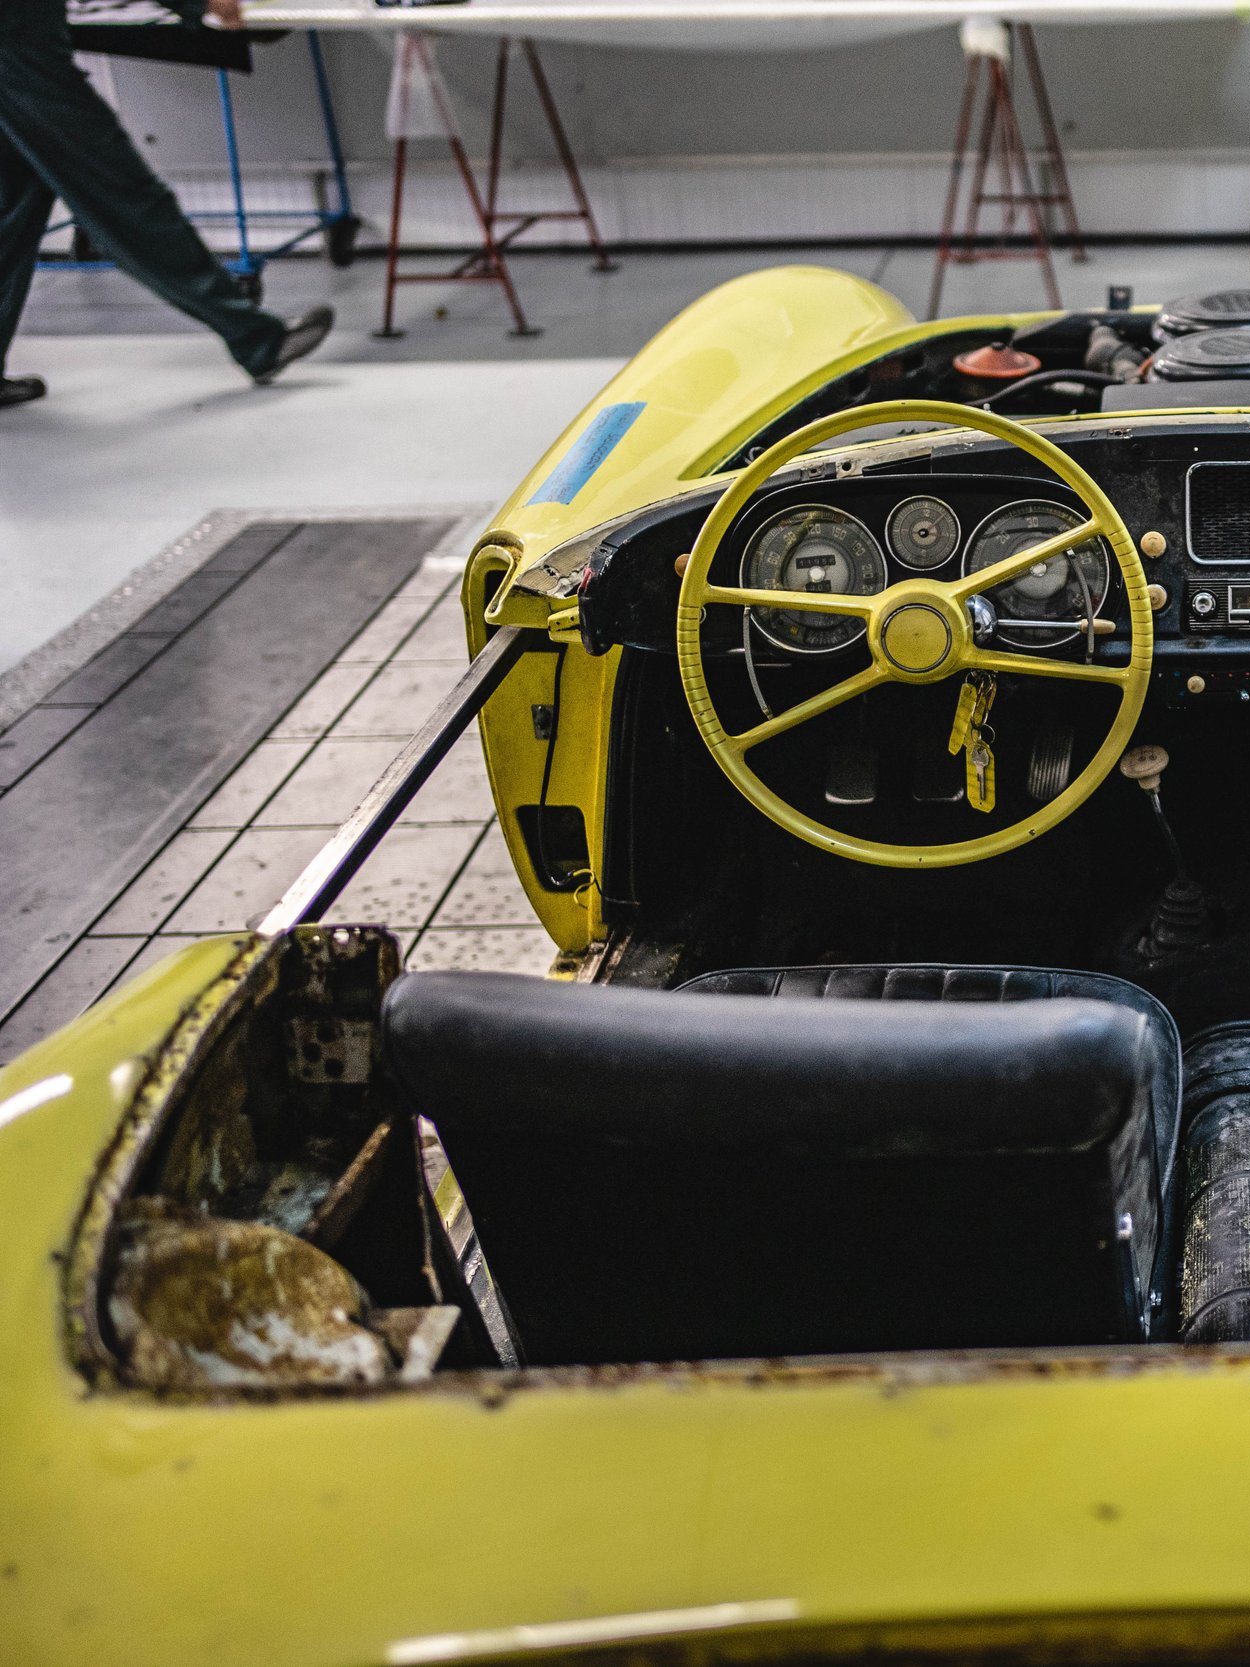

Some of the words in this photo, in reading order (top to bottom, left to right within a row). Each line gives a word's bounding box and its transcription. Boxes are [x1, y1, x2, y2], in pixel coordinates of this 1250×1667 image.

[807, 523, 822, 535] 120
[1025, 516, 1039, 528] 30
[783, 531, 797, 547] 90
[832, 526, 847, 540] 150
[852, 541, 867, 557] 180
[767, 551, 781, 565] 60
[1080, 551, 1093, 565] 50
[862, 564, 874, 579] 210
